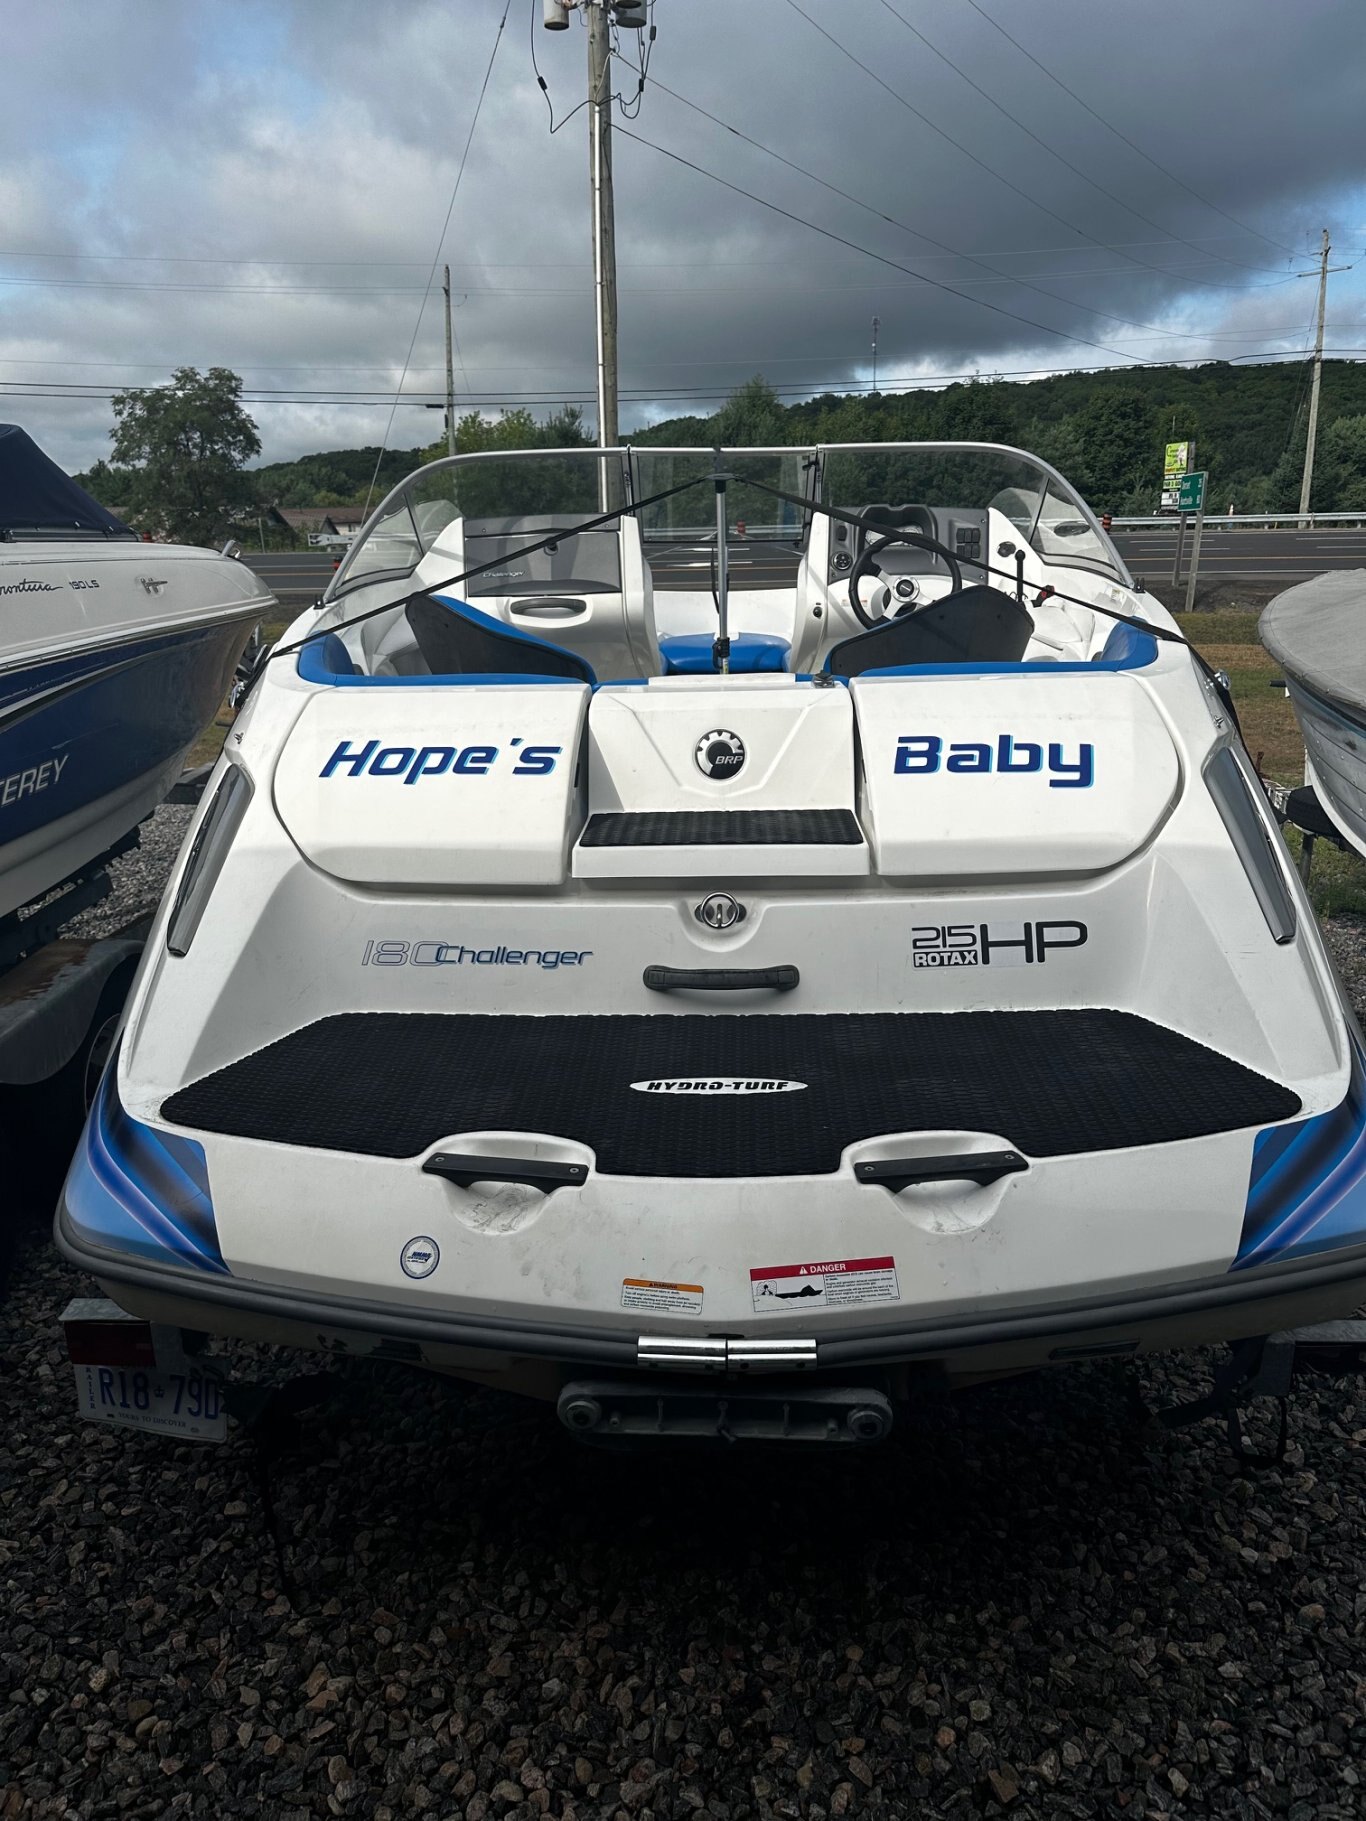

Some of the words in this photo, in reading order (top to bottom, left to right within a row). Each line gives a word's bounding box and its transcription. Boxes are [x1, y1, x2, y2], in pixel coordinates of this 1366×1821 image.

[318, 738, 563, 785] Hope's
[893, 734, 1094, 788] Baby
[715, 755, 743, 765] BRP
[911, 925, 977, 950] 215
[980, 920, 1088, 965] HP
[361, 940, 450, 967] 180
[435, 946, 594, 970] Challenger
[914, 950, 977, 967] ROTAX
[647, 1081, 789, 1091] HYDRO-TURF
[809, 1263, 847, 1274] DANGER
